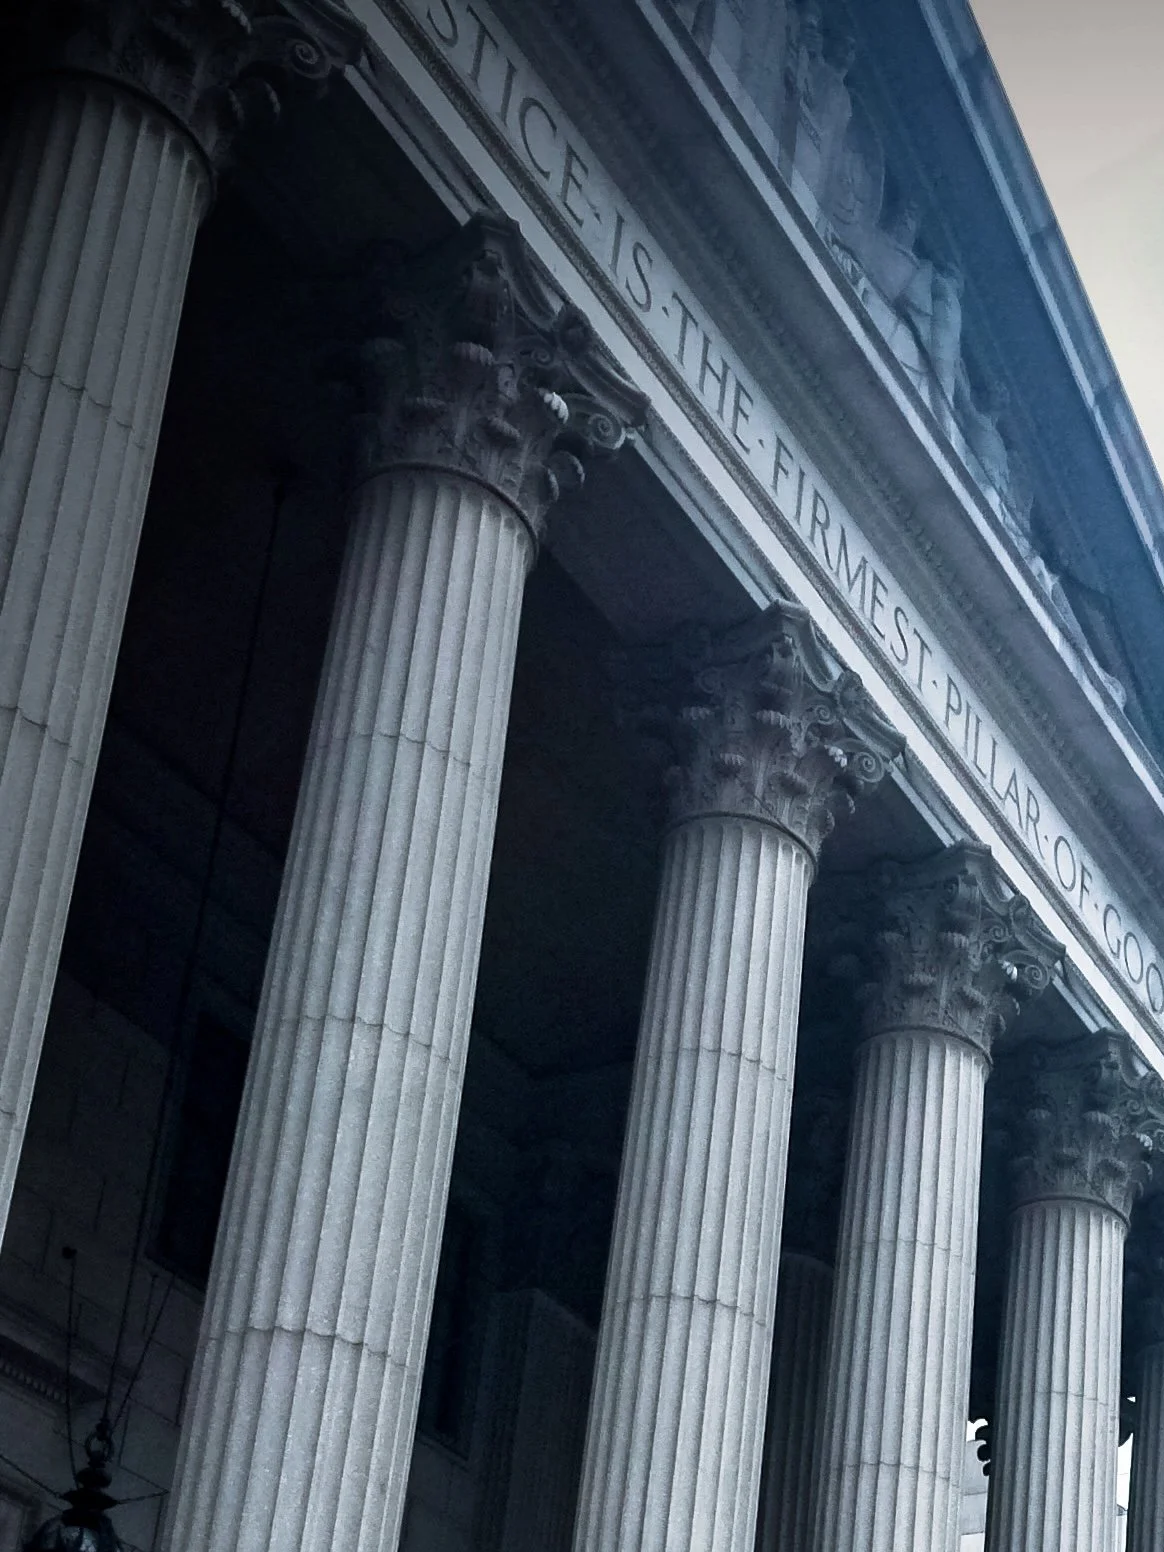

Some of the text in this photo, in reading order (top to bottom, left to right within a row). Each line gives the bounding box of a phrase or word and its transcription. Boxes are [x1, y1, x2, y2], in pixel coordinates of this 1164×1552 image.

[608, 212, 654, 313] IS
[672, 290, 755, 456] THE
[771, 436, 934, 695] FIRMEST
[942, 673, 1046, 861] PILLAR
[1053, 834, 1093, 912] OF
